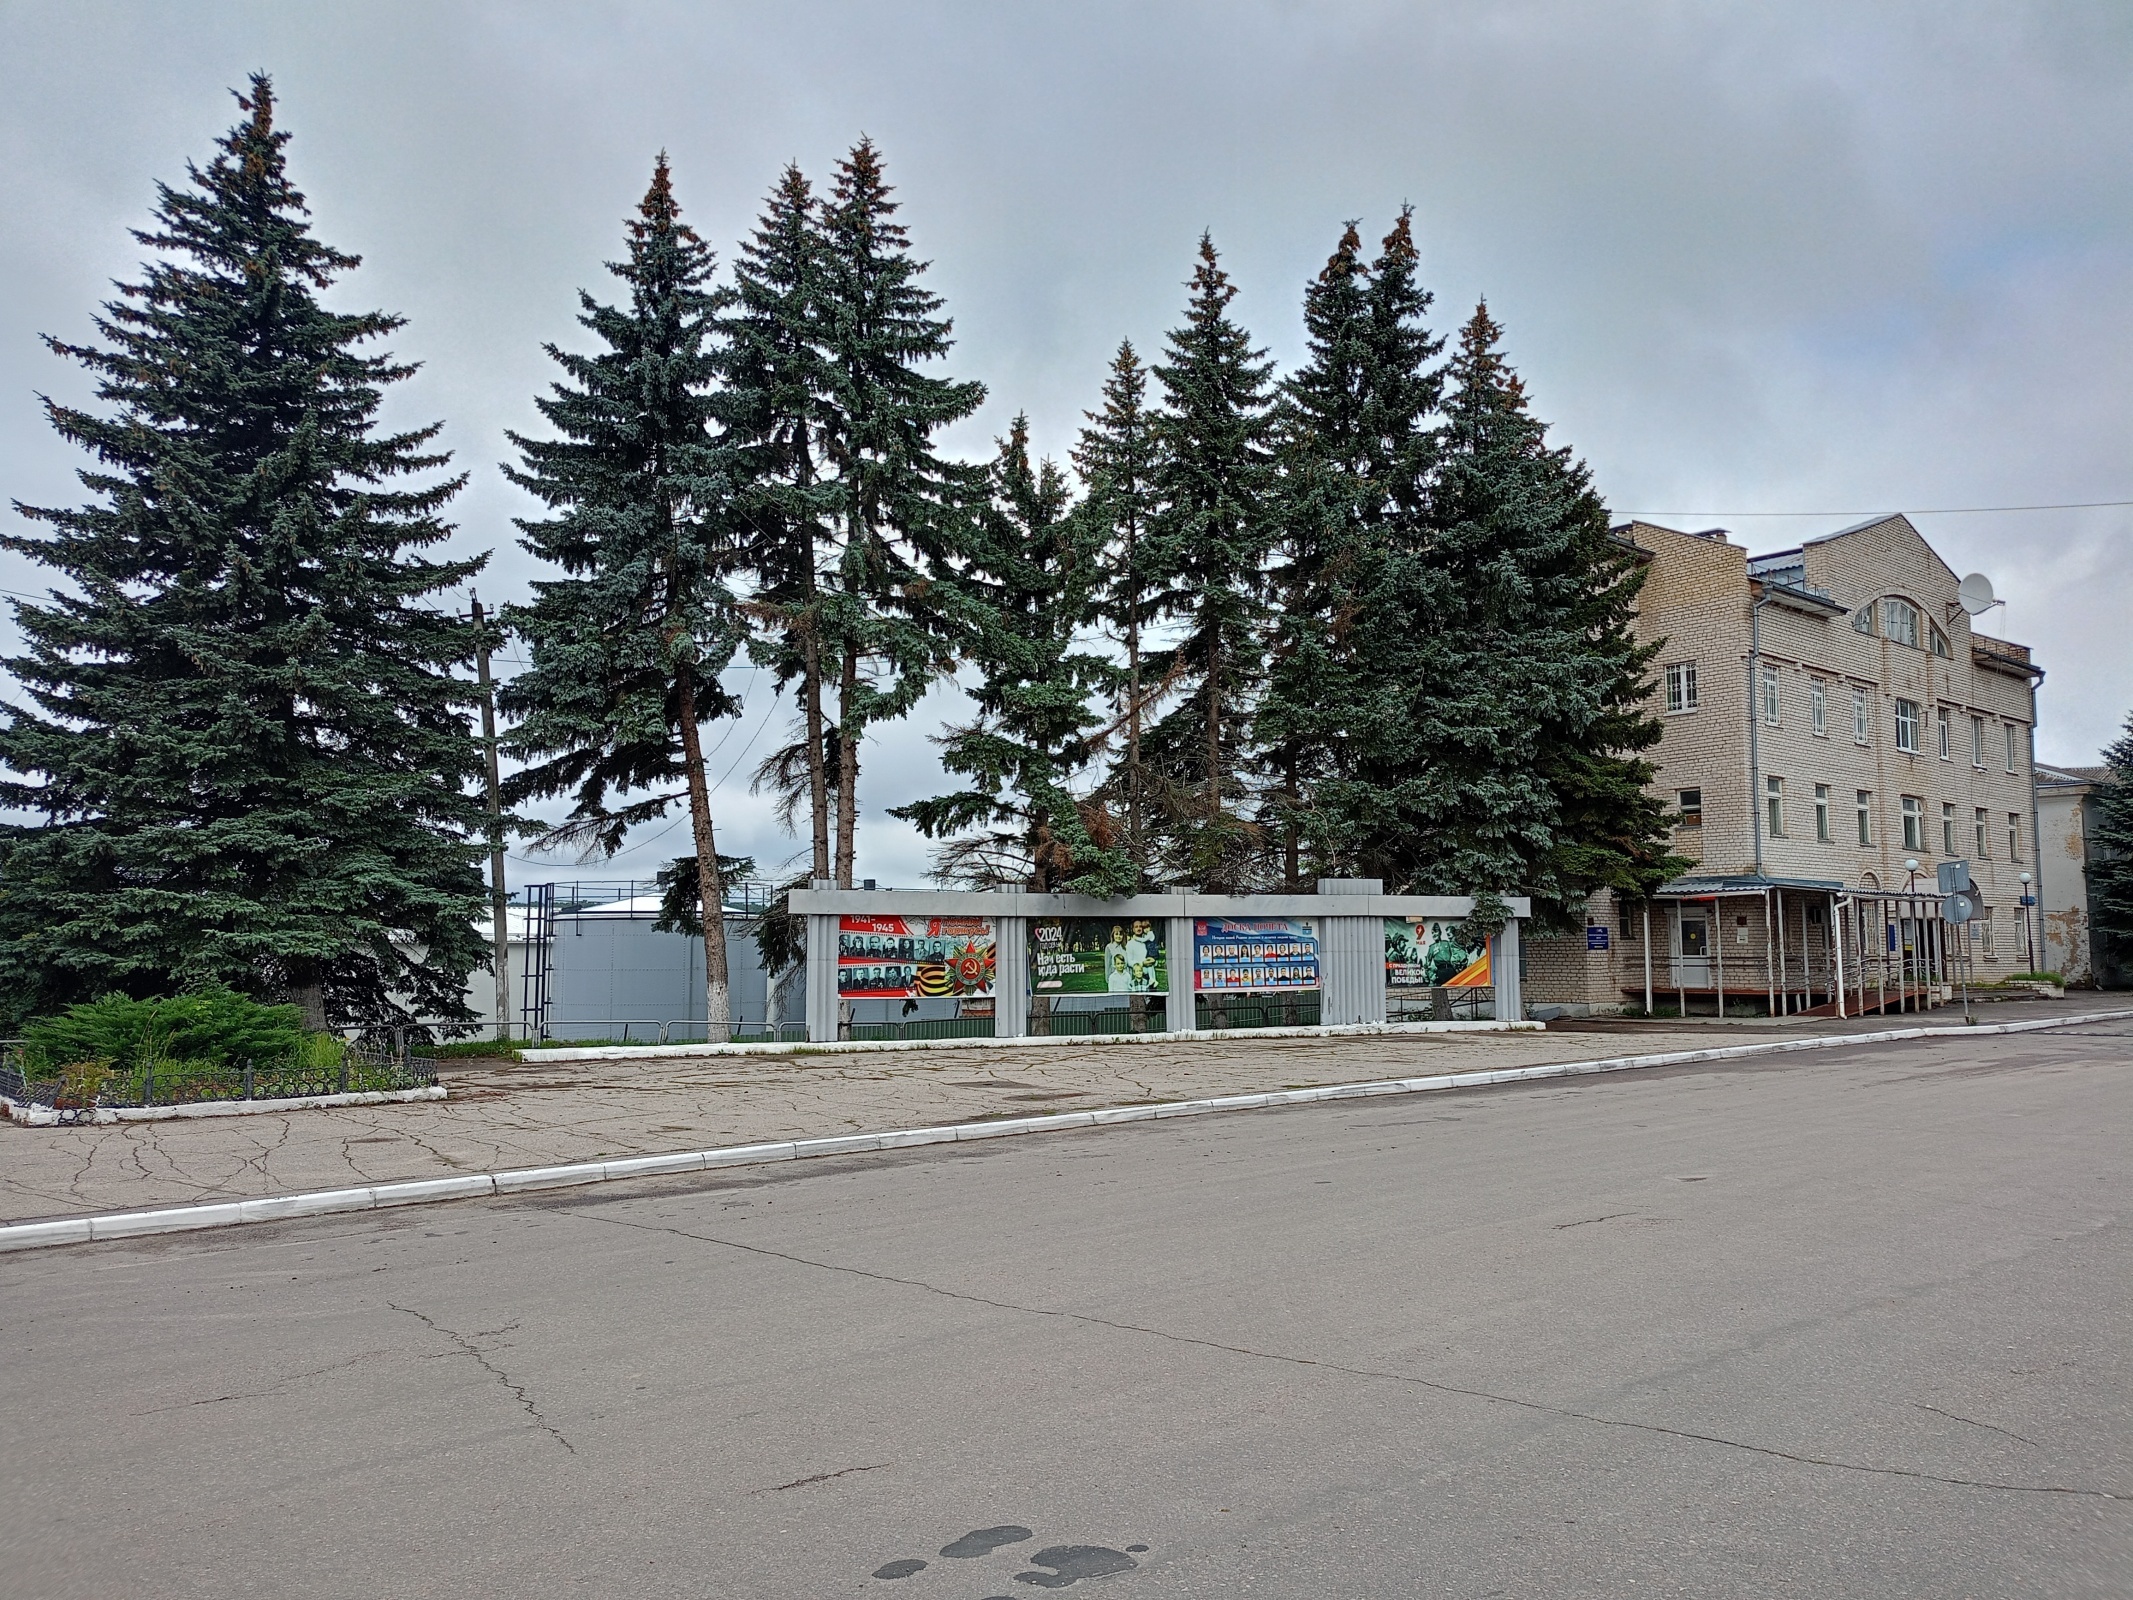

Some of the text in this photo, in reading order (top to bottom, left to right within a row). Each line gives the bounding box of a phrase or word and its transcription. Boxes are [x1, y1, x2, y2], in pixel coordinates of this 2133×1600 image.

[850, 916, 876, 924] 1941-
[872, 924, 894, 932] 1945
[926, 918, 942, 939] Я
[1221, 923, 1250, 933] ДОСКА
[1416, 924, 1425, 940] 9
[1039, 926, 1062, 942] 2024
[1056, 954, 1076, 964] есть
[1059, 964, 1084, 976] расти
